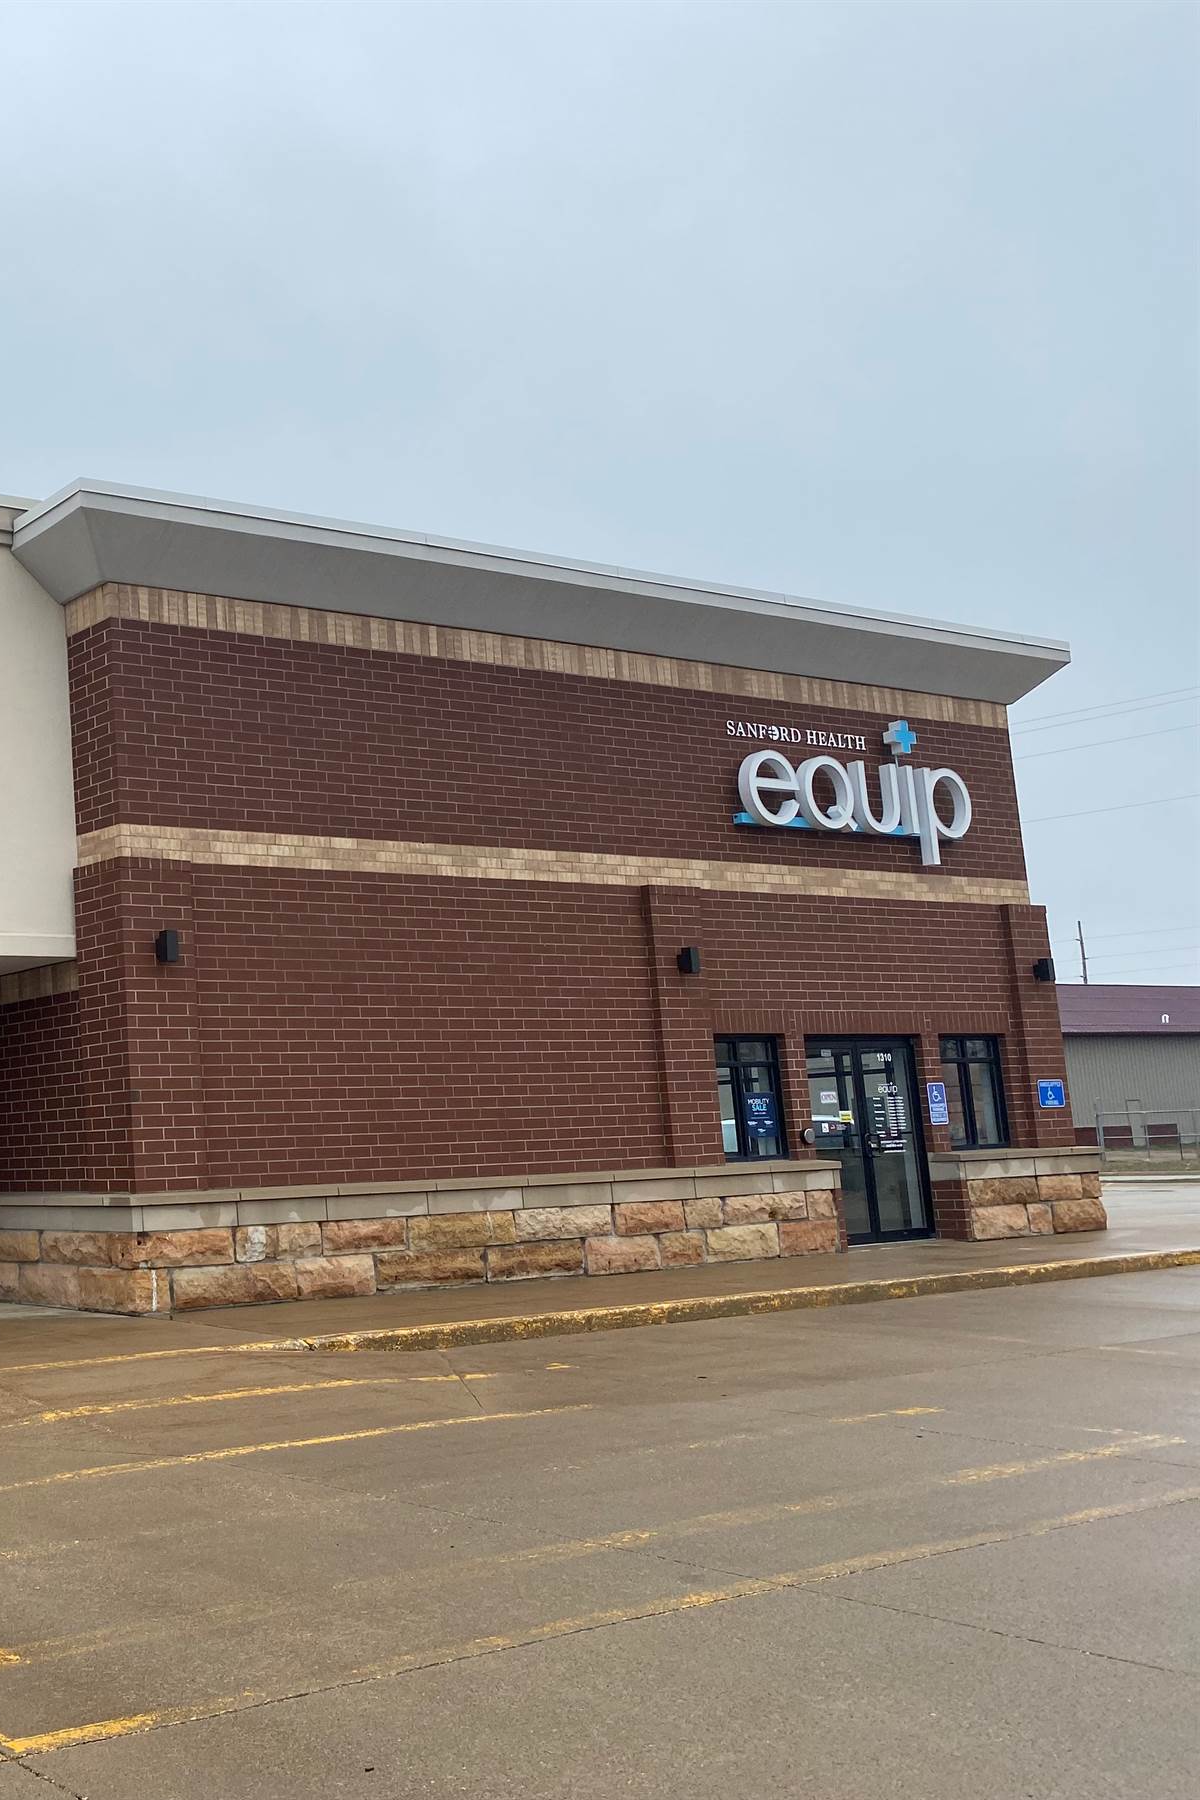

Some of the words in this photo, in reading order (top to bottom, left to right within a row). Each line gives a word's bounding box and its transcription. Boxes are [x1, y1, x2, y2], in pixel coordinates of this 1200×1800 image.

[726, 720, 801, 743] SANFORD
[806, 729, 867, 751] HEALTH
[876, 1053, 892, 1062] 1310
